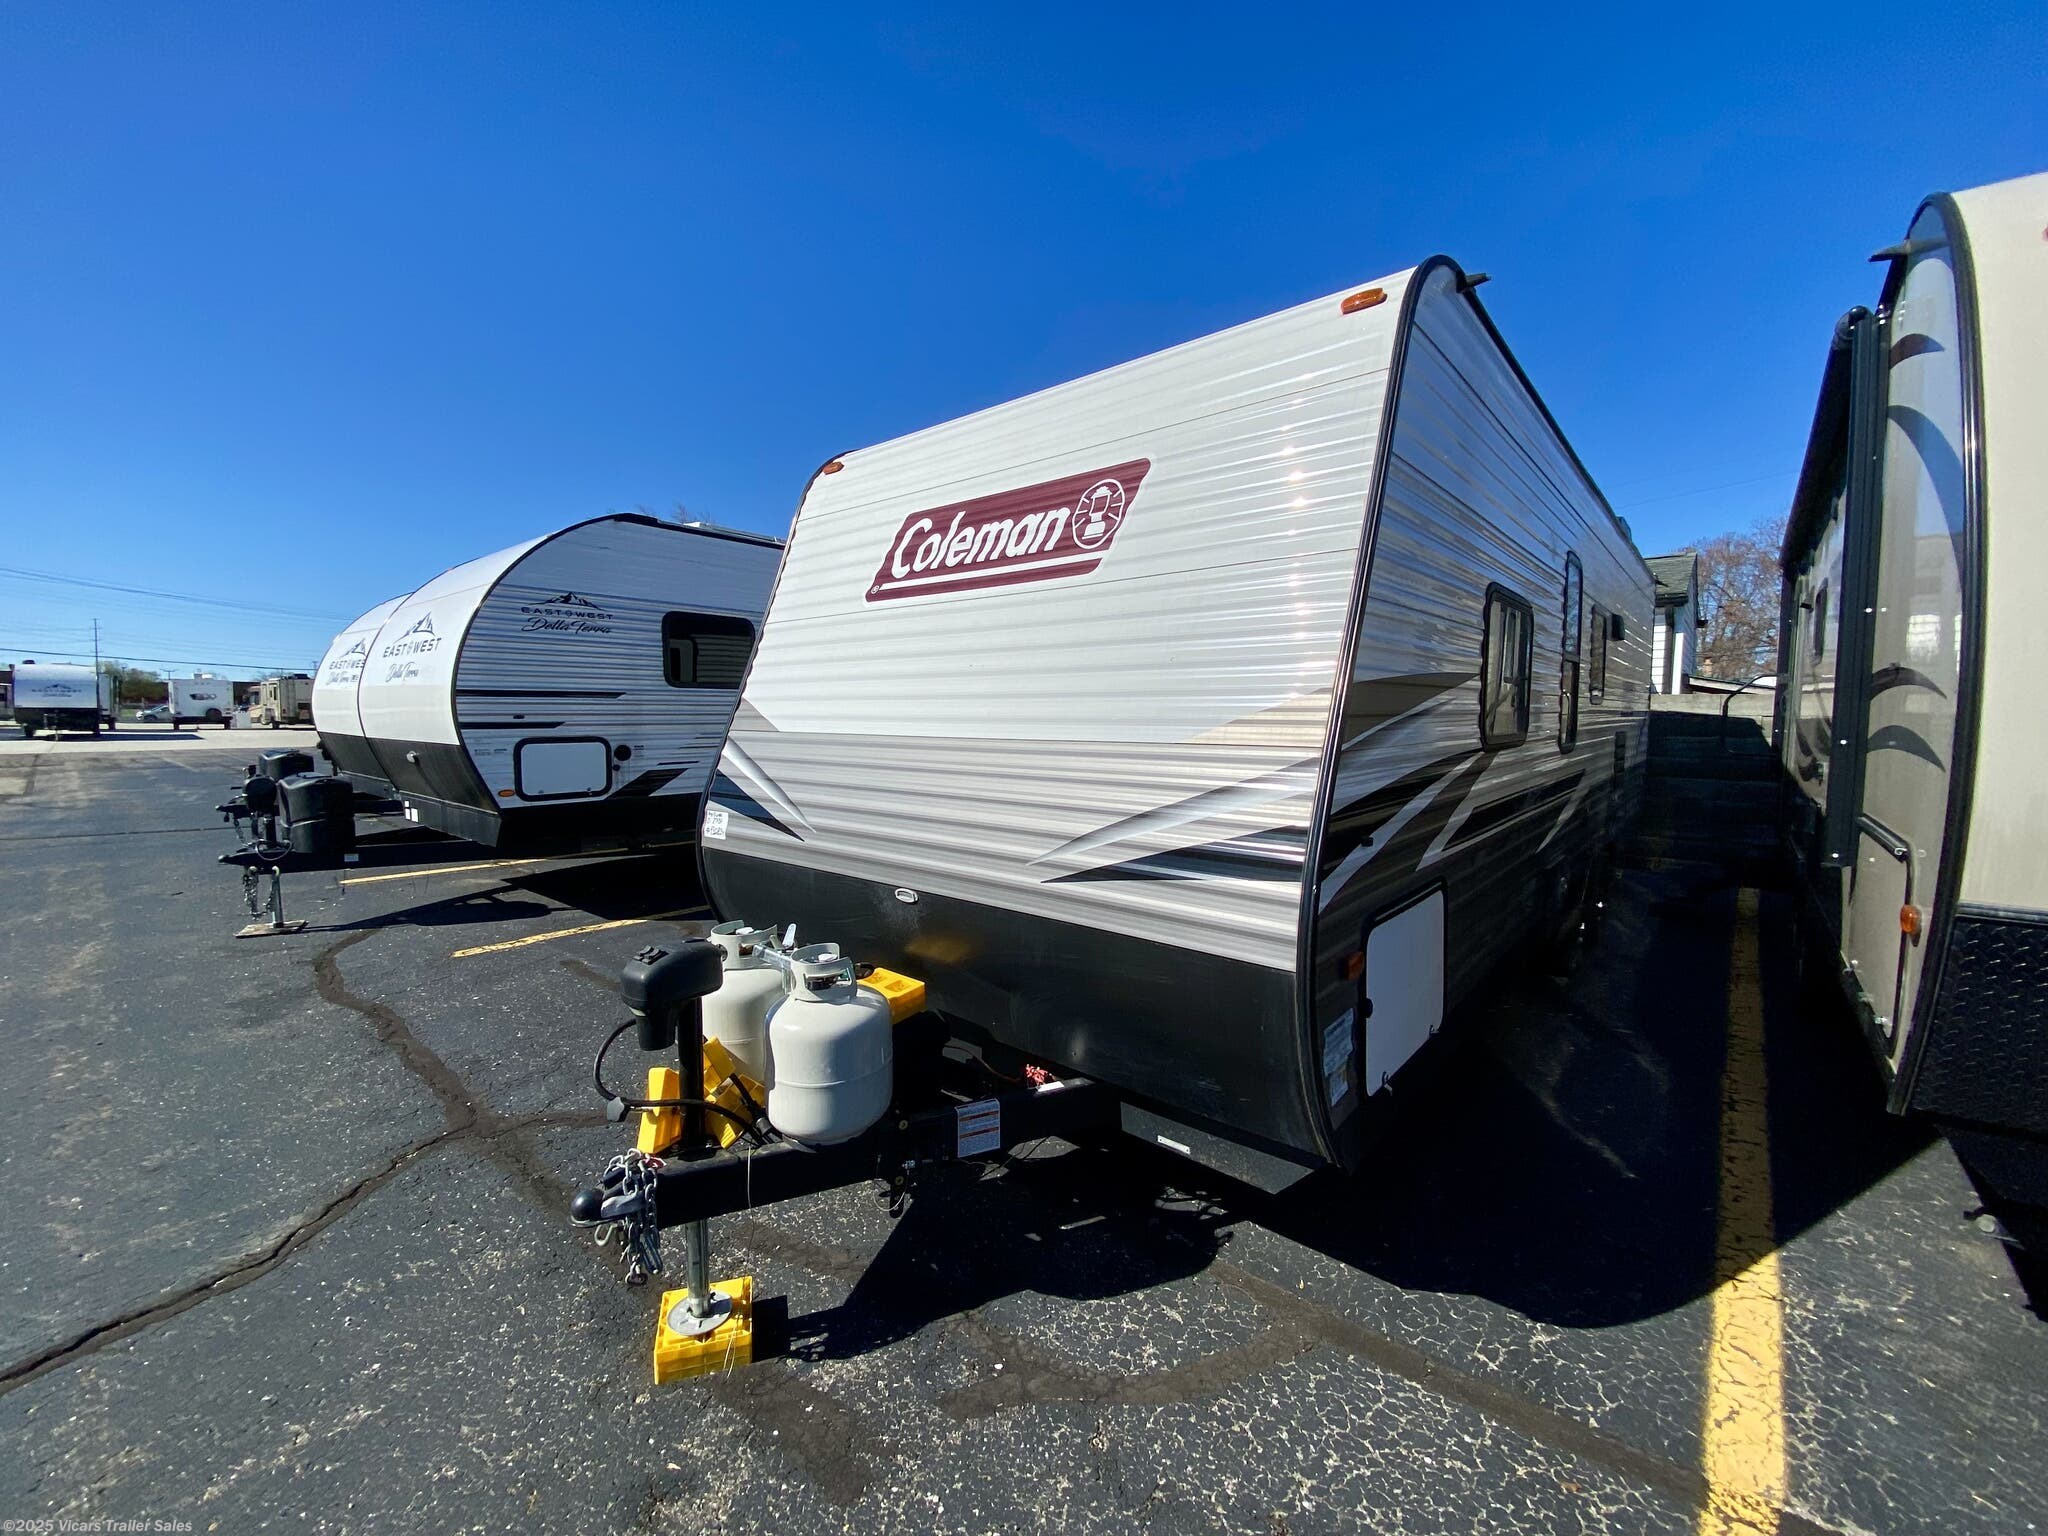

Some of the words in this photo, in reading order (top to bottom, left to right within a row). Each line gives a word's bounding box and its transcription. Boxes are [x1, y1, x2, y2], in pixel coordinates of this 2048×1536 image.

[891, 506, 1071, 579] Coleman
[383, 643, 408, 658] EAST
[413, 637, 442, 654] WEST
